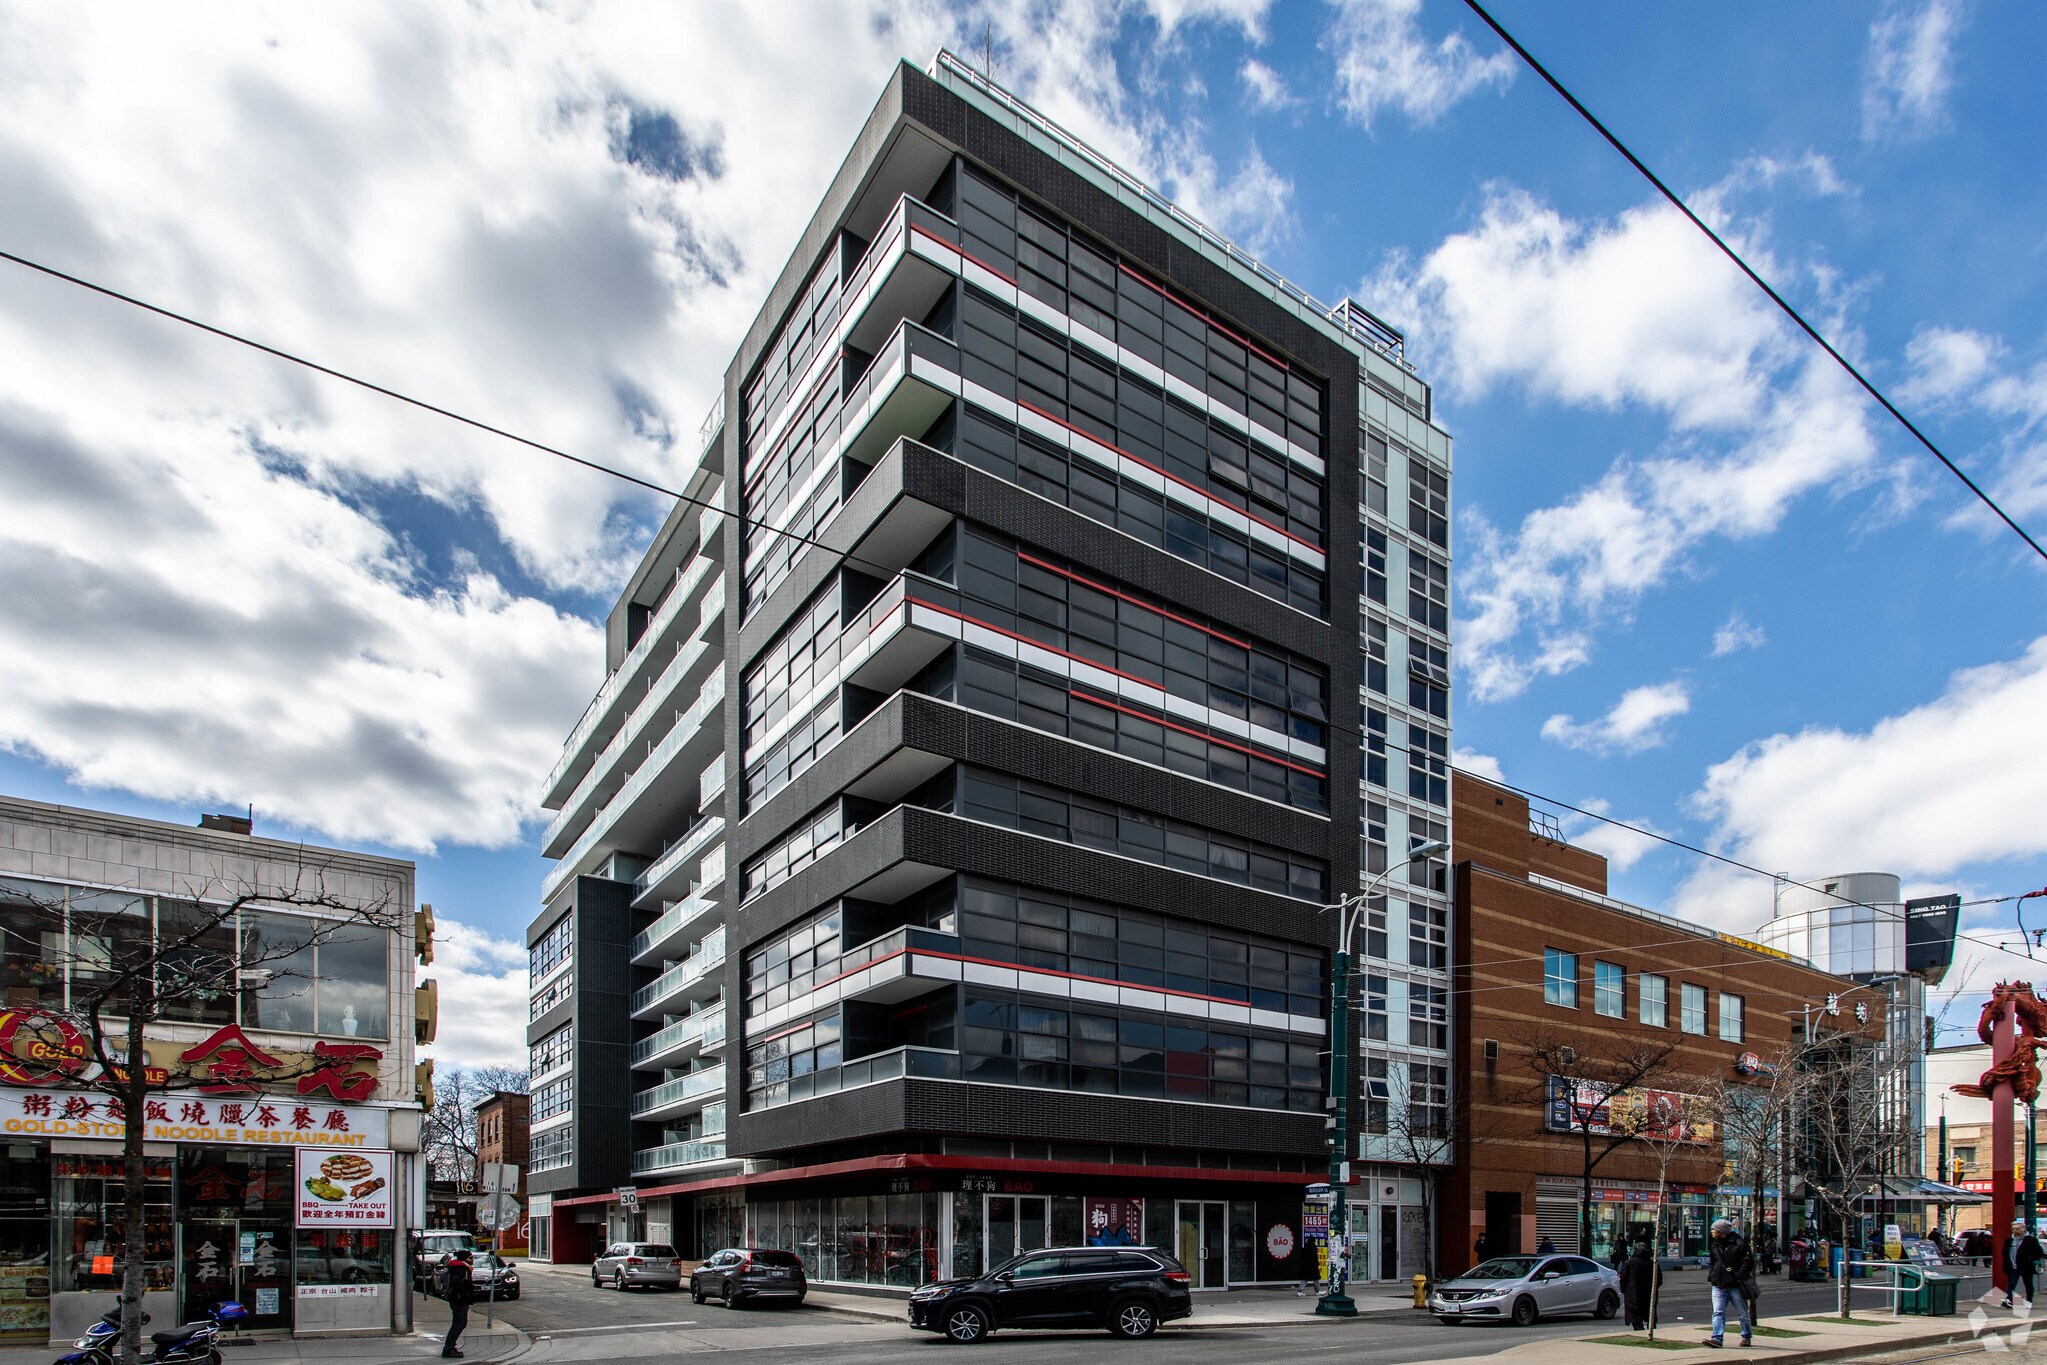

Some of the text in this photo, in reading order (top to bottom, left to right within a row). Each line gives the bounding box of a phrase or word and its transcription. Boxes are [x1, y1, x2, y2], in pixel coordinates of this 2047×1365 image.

[154, 1125, 238, 1141] NOODLE
[243, 1129, 367, 1146] RESTAURANT
[622, 1194, 636, 1204] 30
